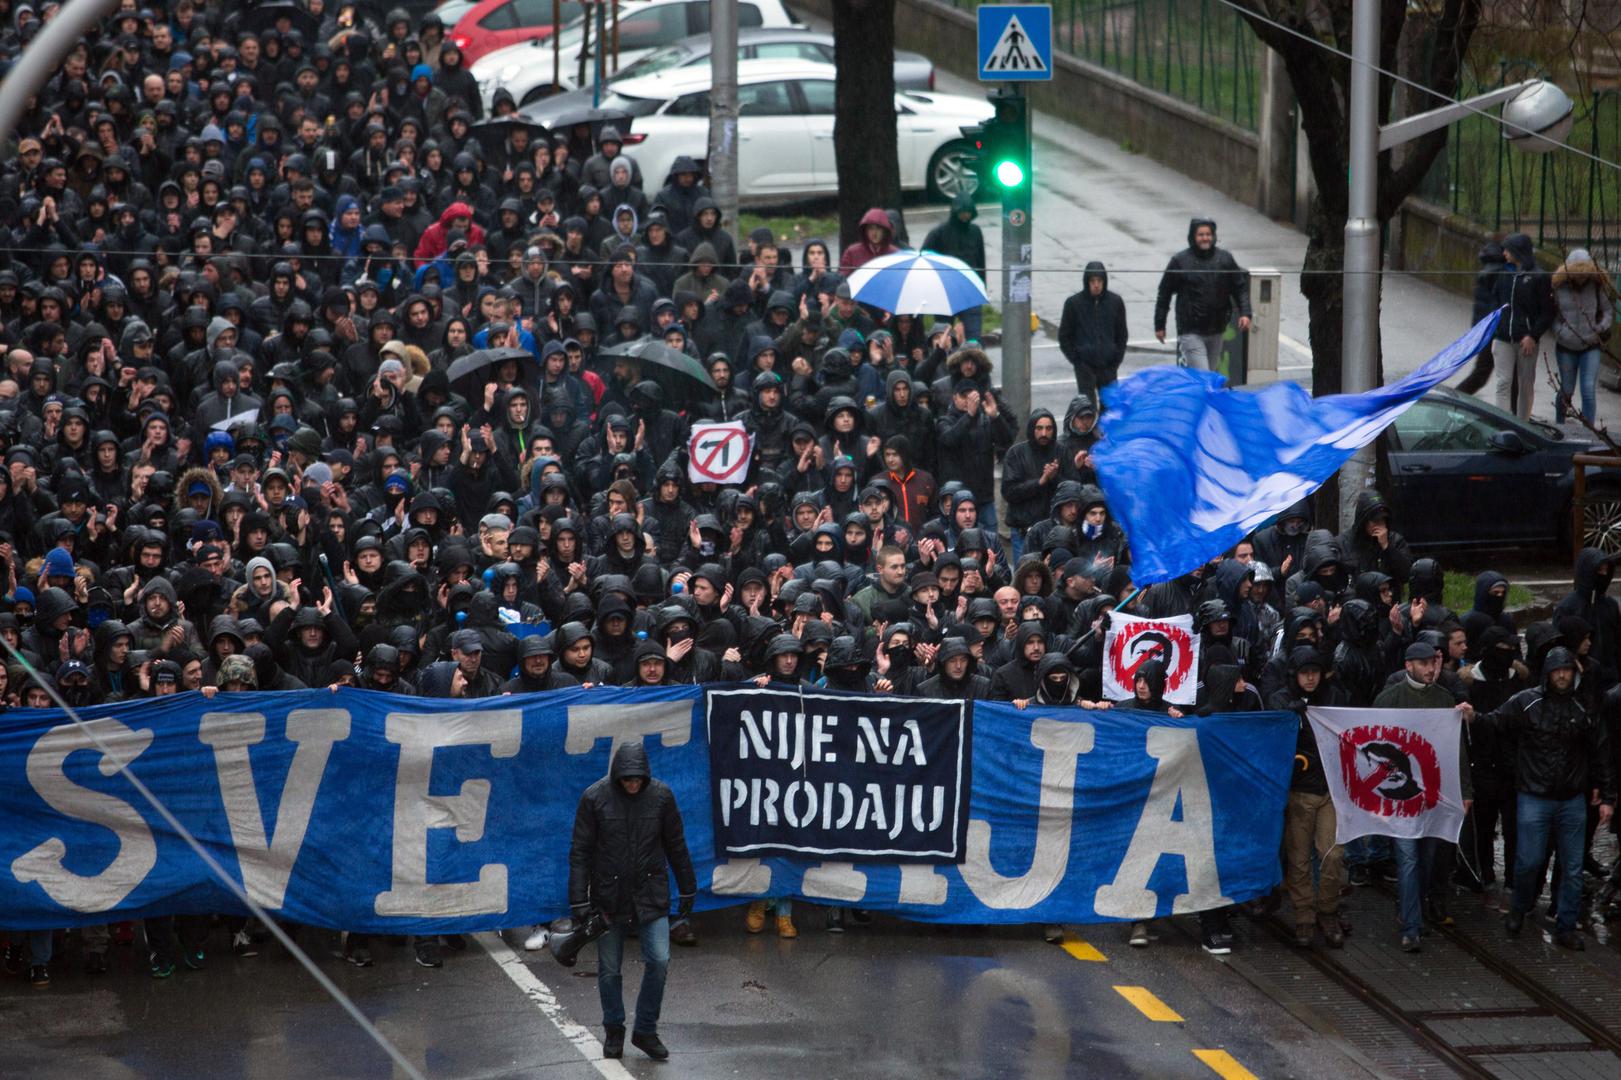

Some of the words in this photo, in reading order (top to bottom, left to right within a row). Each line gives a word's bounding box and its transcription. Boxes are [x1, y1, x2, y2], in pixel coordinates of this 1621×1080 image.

[739, 710, 839, 771] NIJE
[855, 716, 927, 766] NA
[11, 698, 1237, 918] SVETJA
[719, 778, 945, 840] PRODAJU
